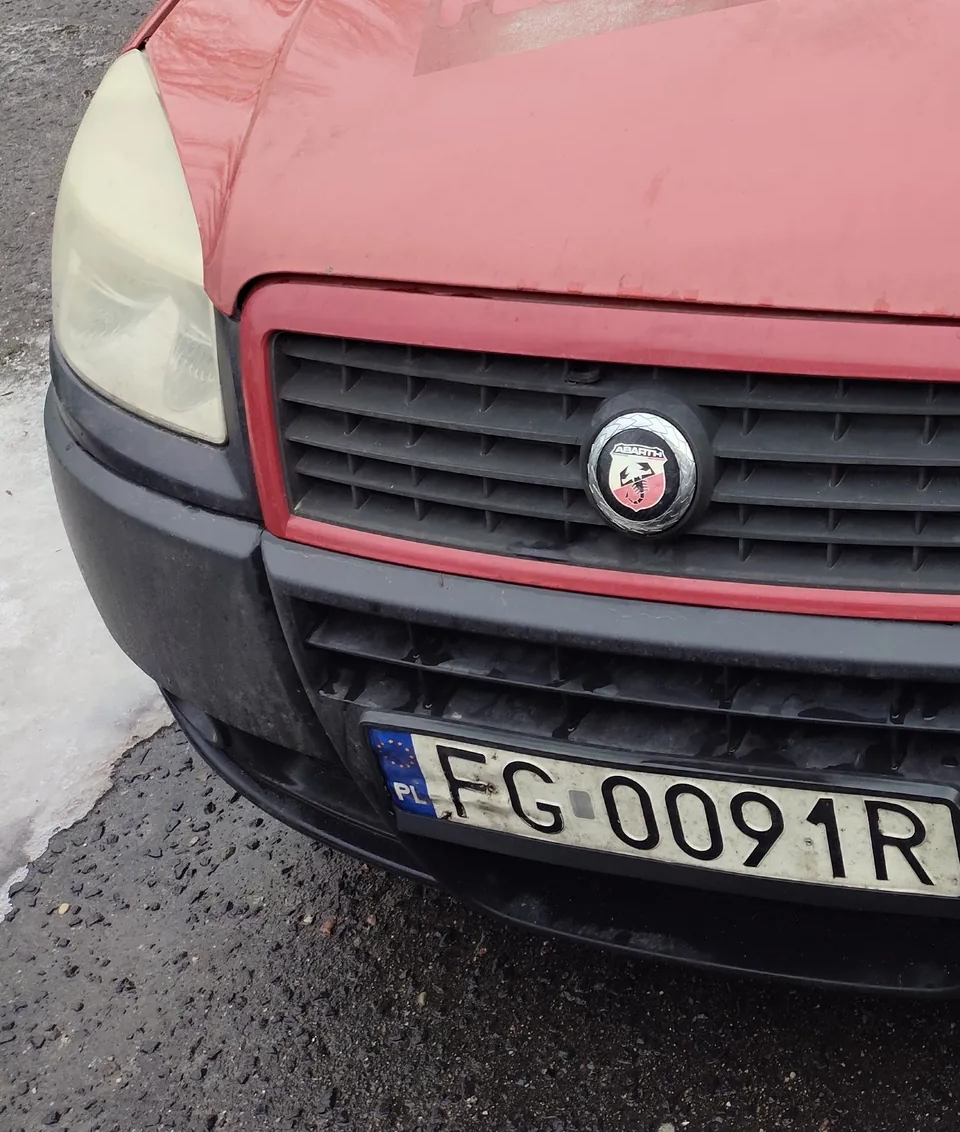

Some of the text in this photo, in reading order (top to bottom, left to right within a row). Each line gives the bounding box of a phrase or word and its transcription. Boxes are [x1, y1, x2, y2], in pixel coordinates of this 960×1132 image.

[615, 446, 663, 458] ABARTH
[393, 782, 427, 805] PL
[436, 744, 935, 887] FG 0091R
